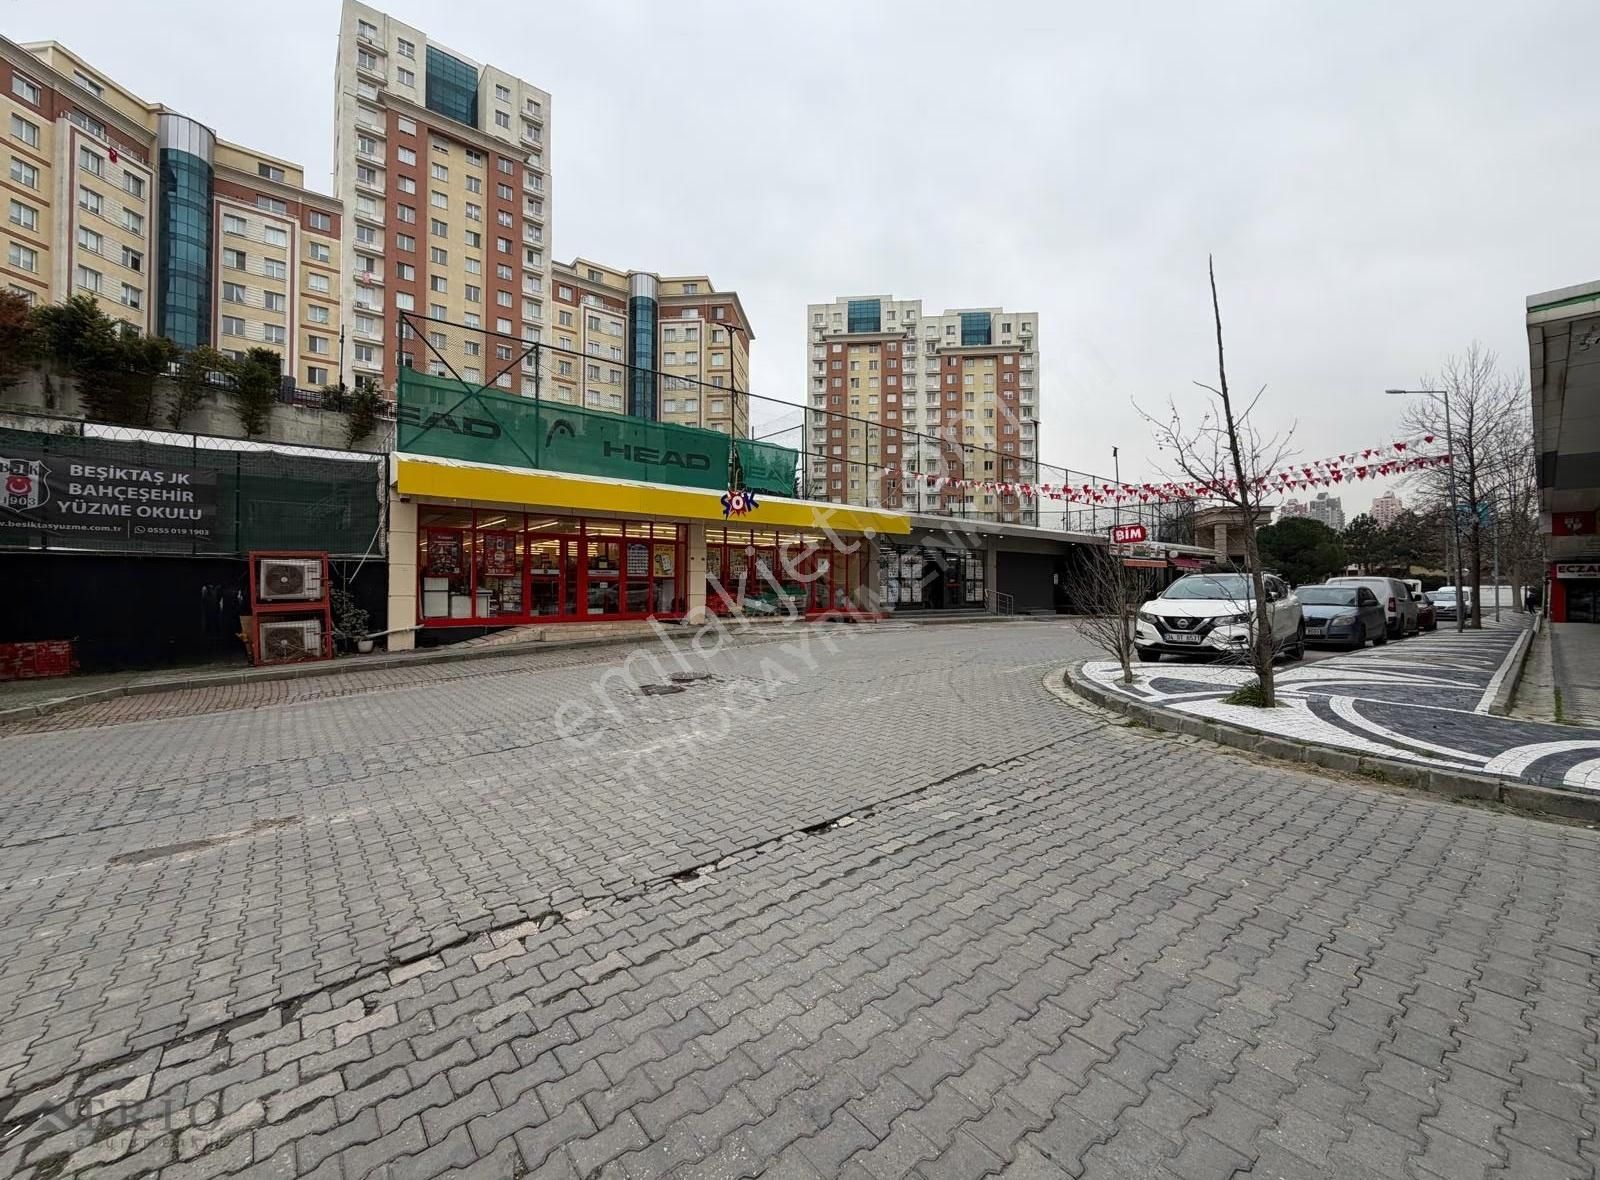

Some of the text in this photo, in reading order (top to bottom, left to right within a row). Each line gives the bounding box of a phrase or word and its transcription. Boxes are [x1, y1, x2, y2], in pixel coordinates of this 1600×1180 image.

[603, 440, 711, 471] HEAD
[70, 464, 191, 486] BEŞİKTAŞ JK
[3, 495, 36, 506] 1903
[68, 482, 194, 503] BAHÇEŞEHİR
[56, 499, 202, 520] YÜZME OKULU
[1115, 527, 1142, 541] BİM
[1558, 565, 1600, 573] ECZA
